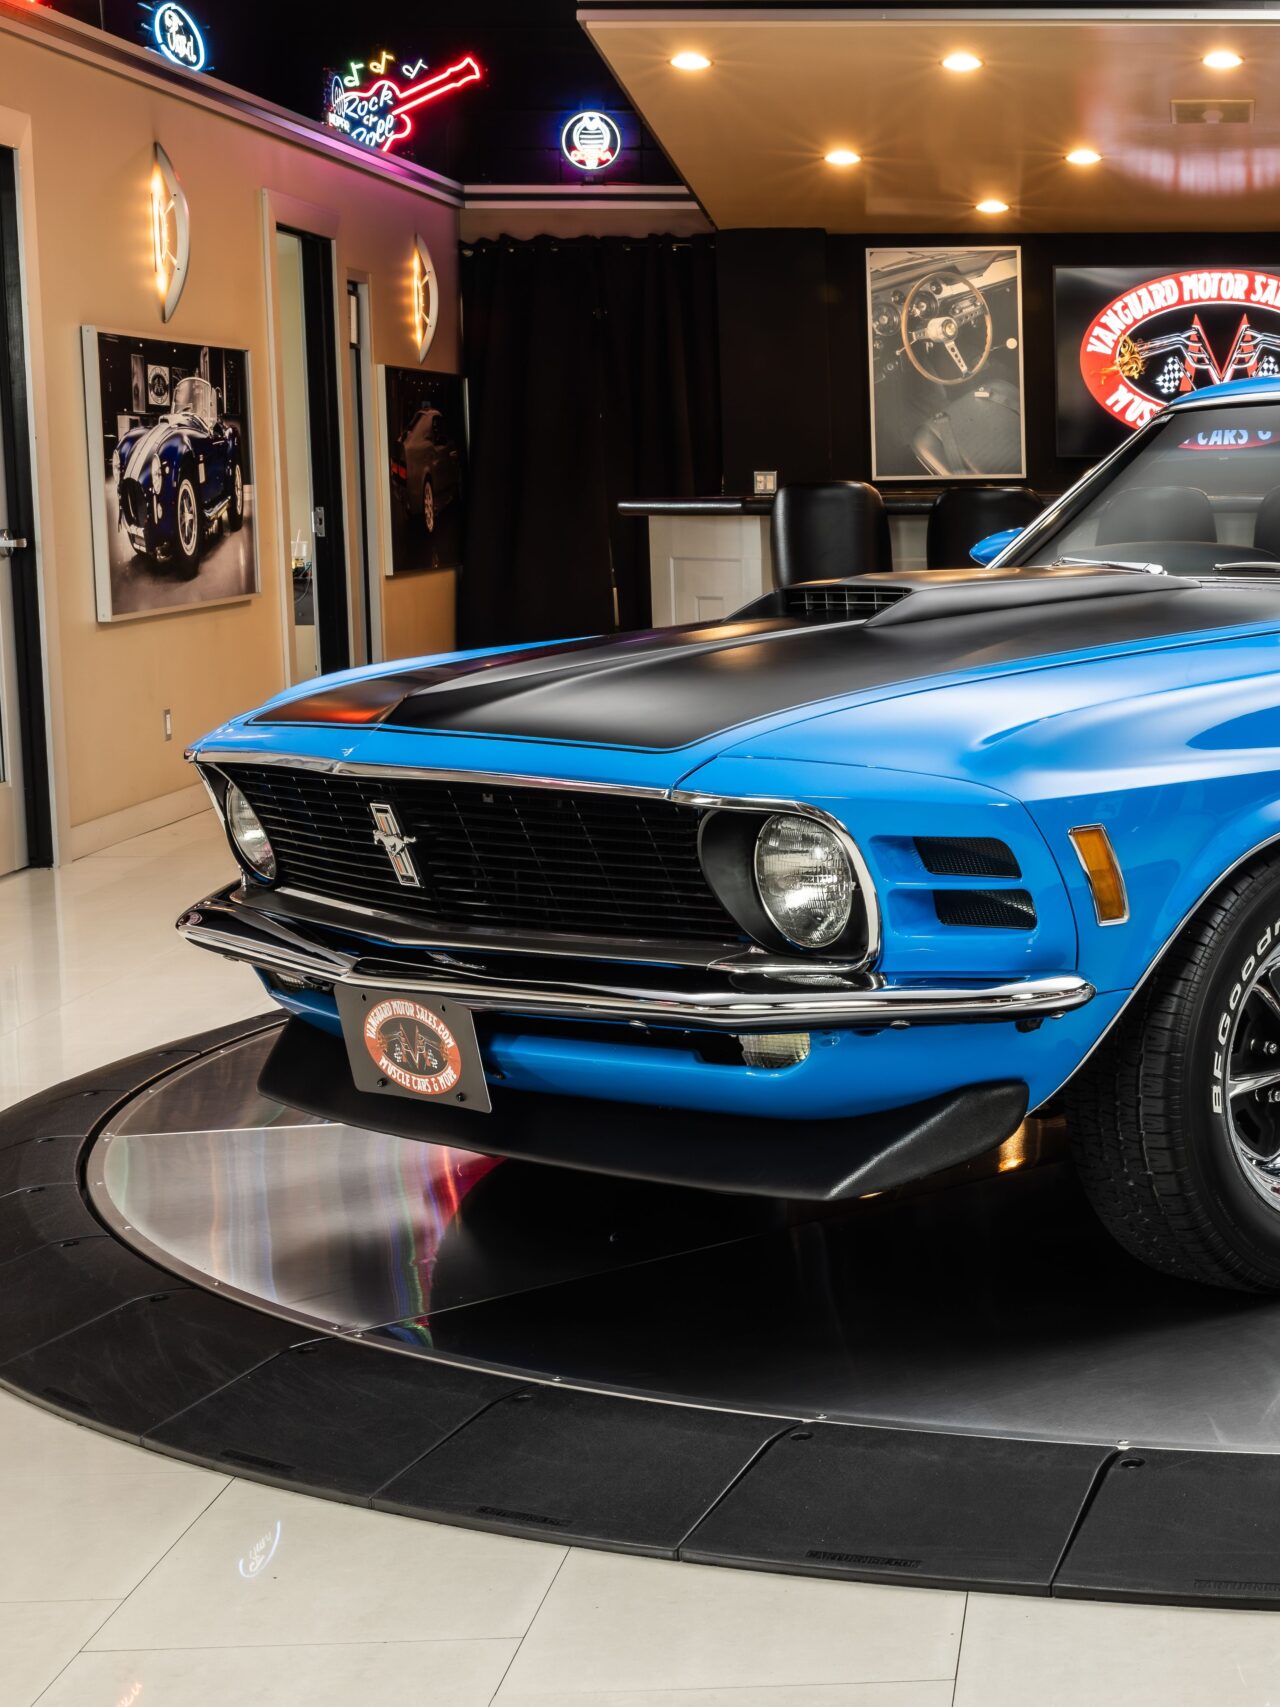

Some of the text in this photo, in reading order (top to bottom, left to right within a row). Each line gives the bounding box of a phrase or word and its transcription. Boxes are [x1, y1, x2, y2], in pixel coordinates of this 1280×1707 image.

[344, 83, 394, 119] Rock
[1086, 280, 1179, 355] VANGUARD
[1180, 272, 1249, 302] MOTOR
[366, 1001, 455, 1048] VANGUARD MOTOR SALES.COM
[379, 1055, 457, 1092] MUSCLE CARS & MORE
